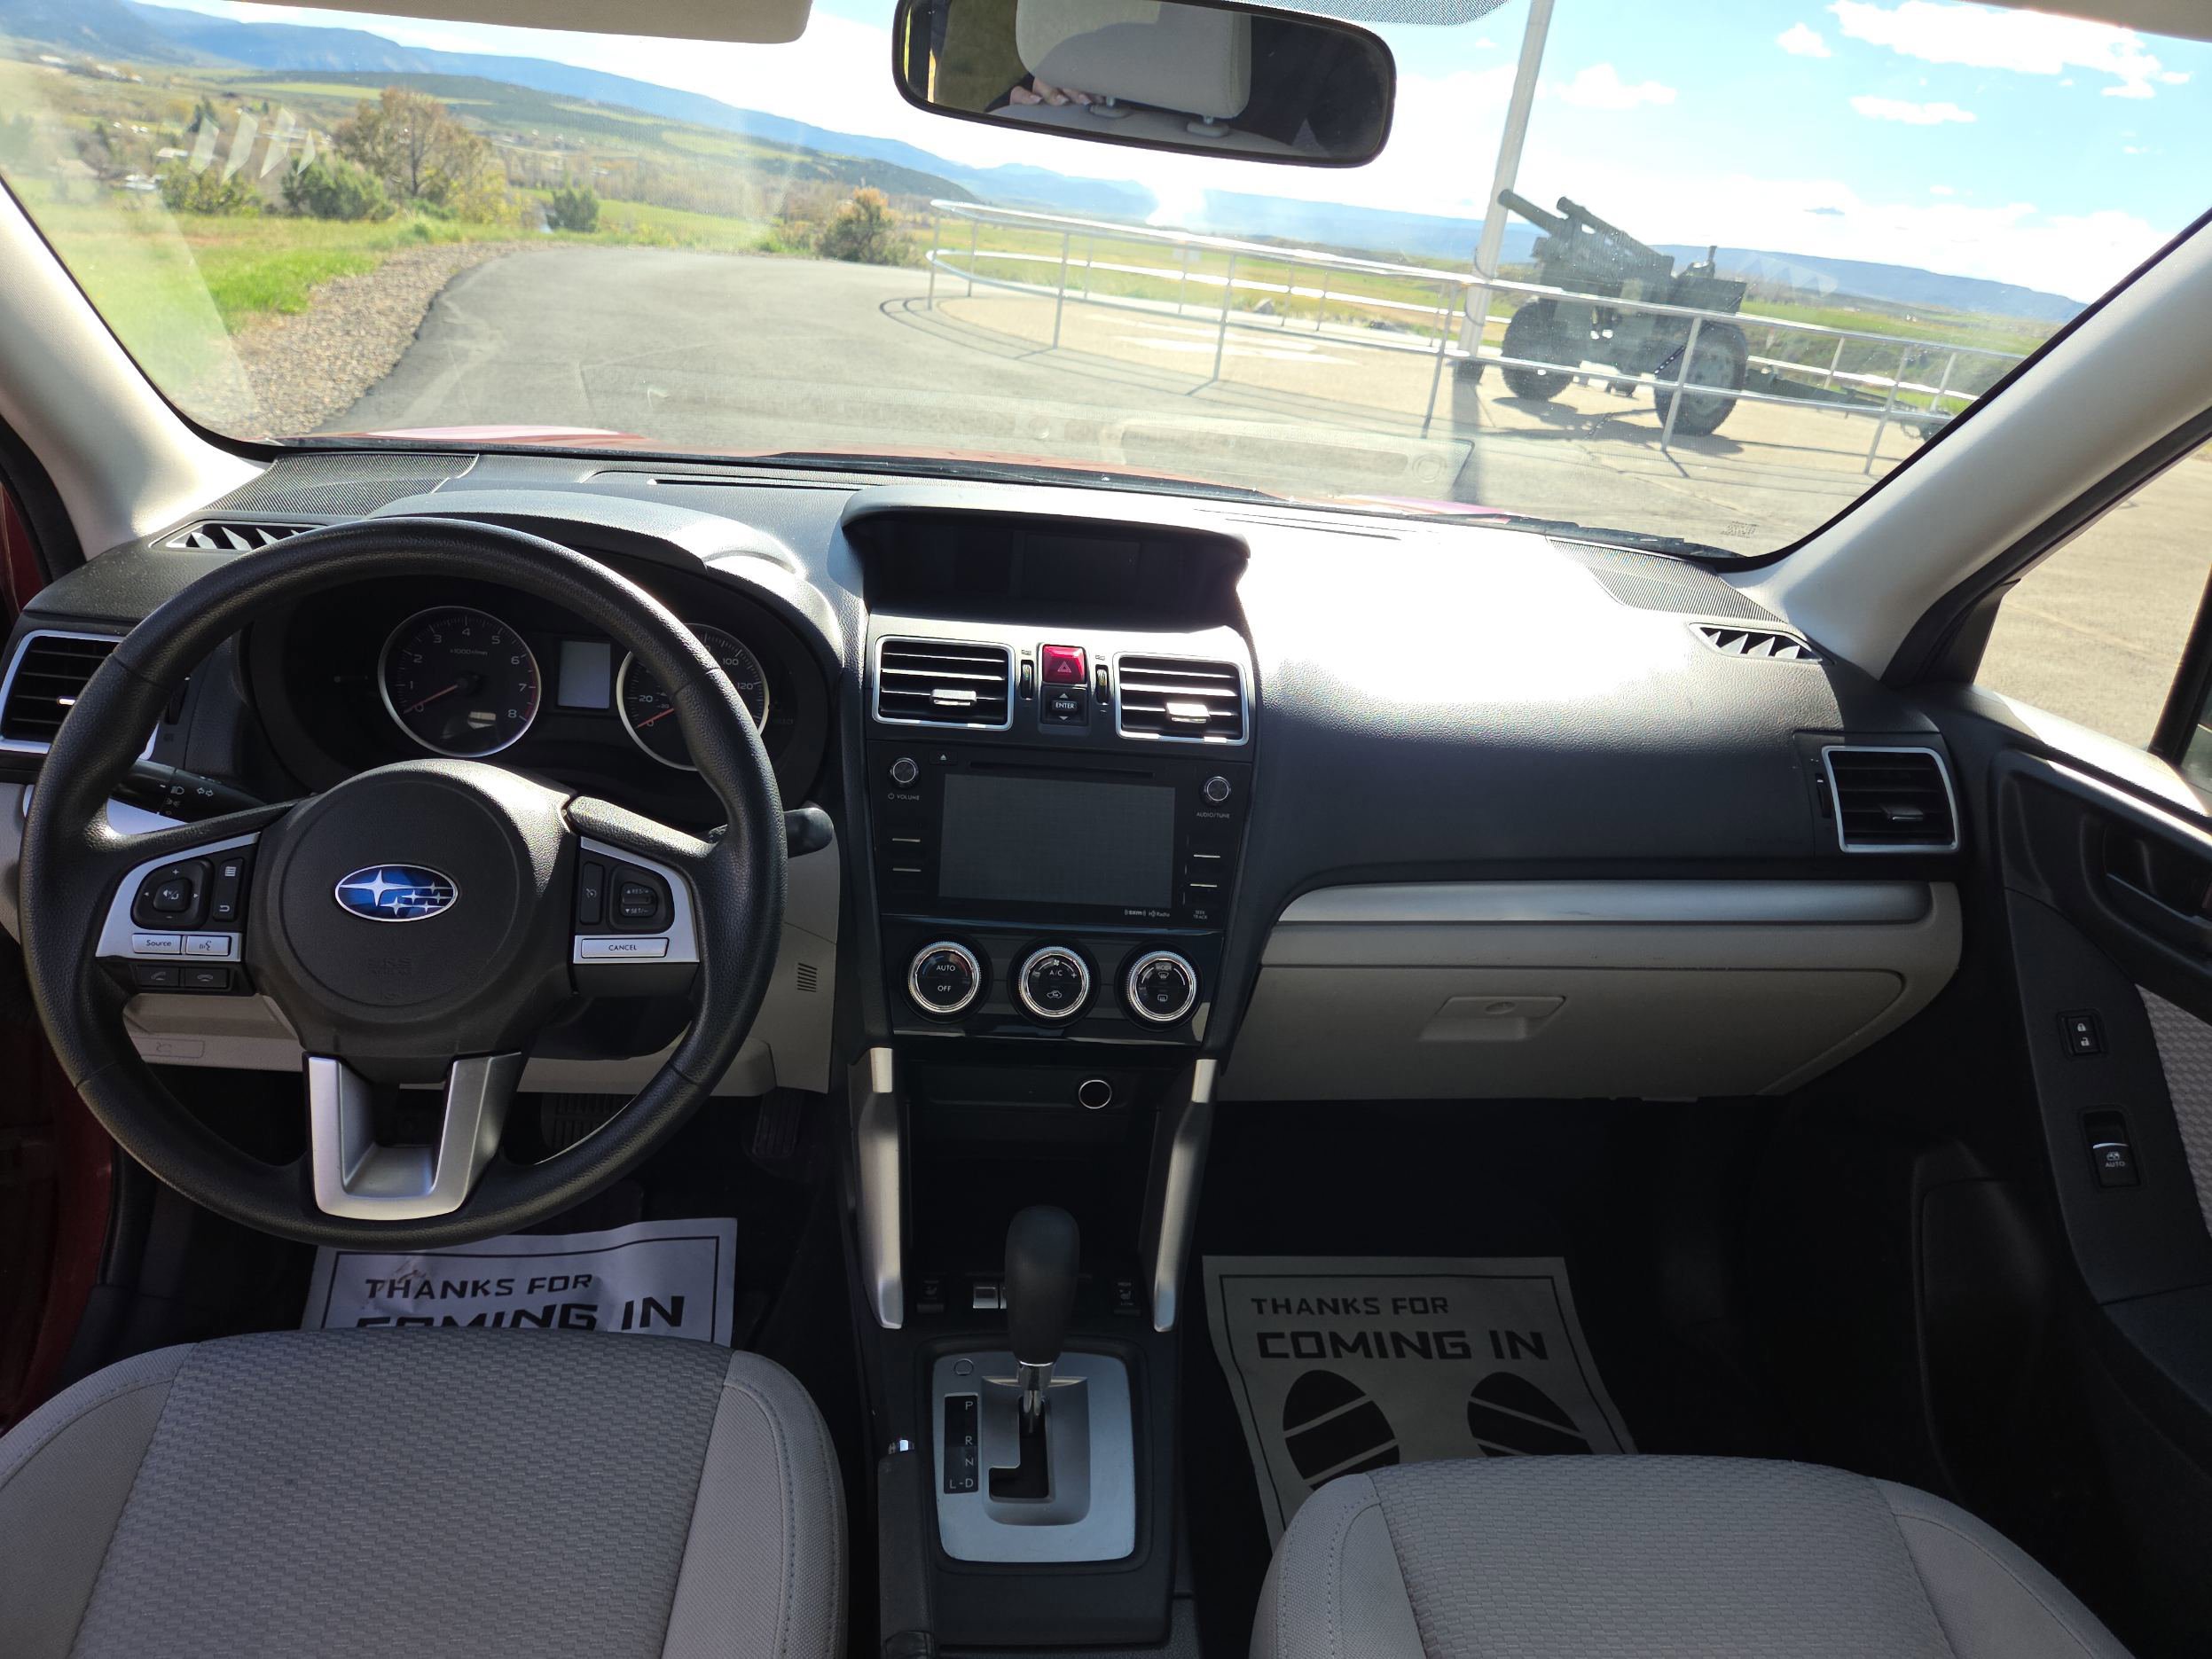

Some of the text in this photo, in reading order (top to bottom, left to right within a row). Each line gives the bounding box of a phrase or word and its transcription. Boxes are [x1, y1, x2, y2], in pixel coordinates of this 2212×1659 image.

[461, 628, 471, 637] 4
[433, 634, 443, 644] 3
[491, 635, 501, 645] 5
[413, 653, 423, 663] 2
[511, 656, 521, 665] 6
[723, 658, 739, 667] 100
[518, 683, 528, 692] 7
[507, 708, 517, 718] 8
[365, 1274, 593, 1300] THANKS FOR
[1251, 1296, 1449, 1315] THANKS FOR
[621, 1295, 686, 1330] IN
[1256, 1330, 1549, 1360] COMING IN
[964, 1401, 974, 1411] P
[964, 1436, 973, 1445] R
[964, 1457, 975, 1467] N
